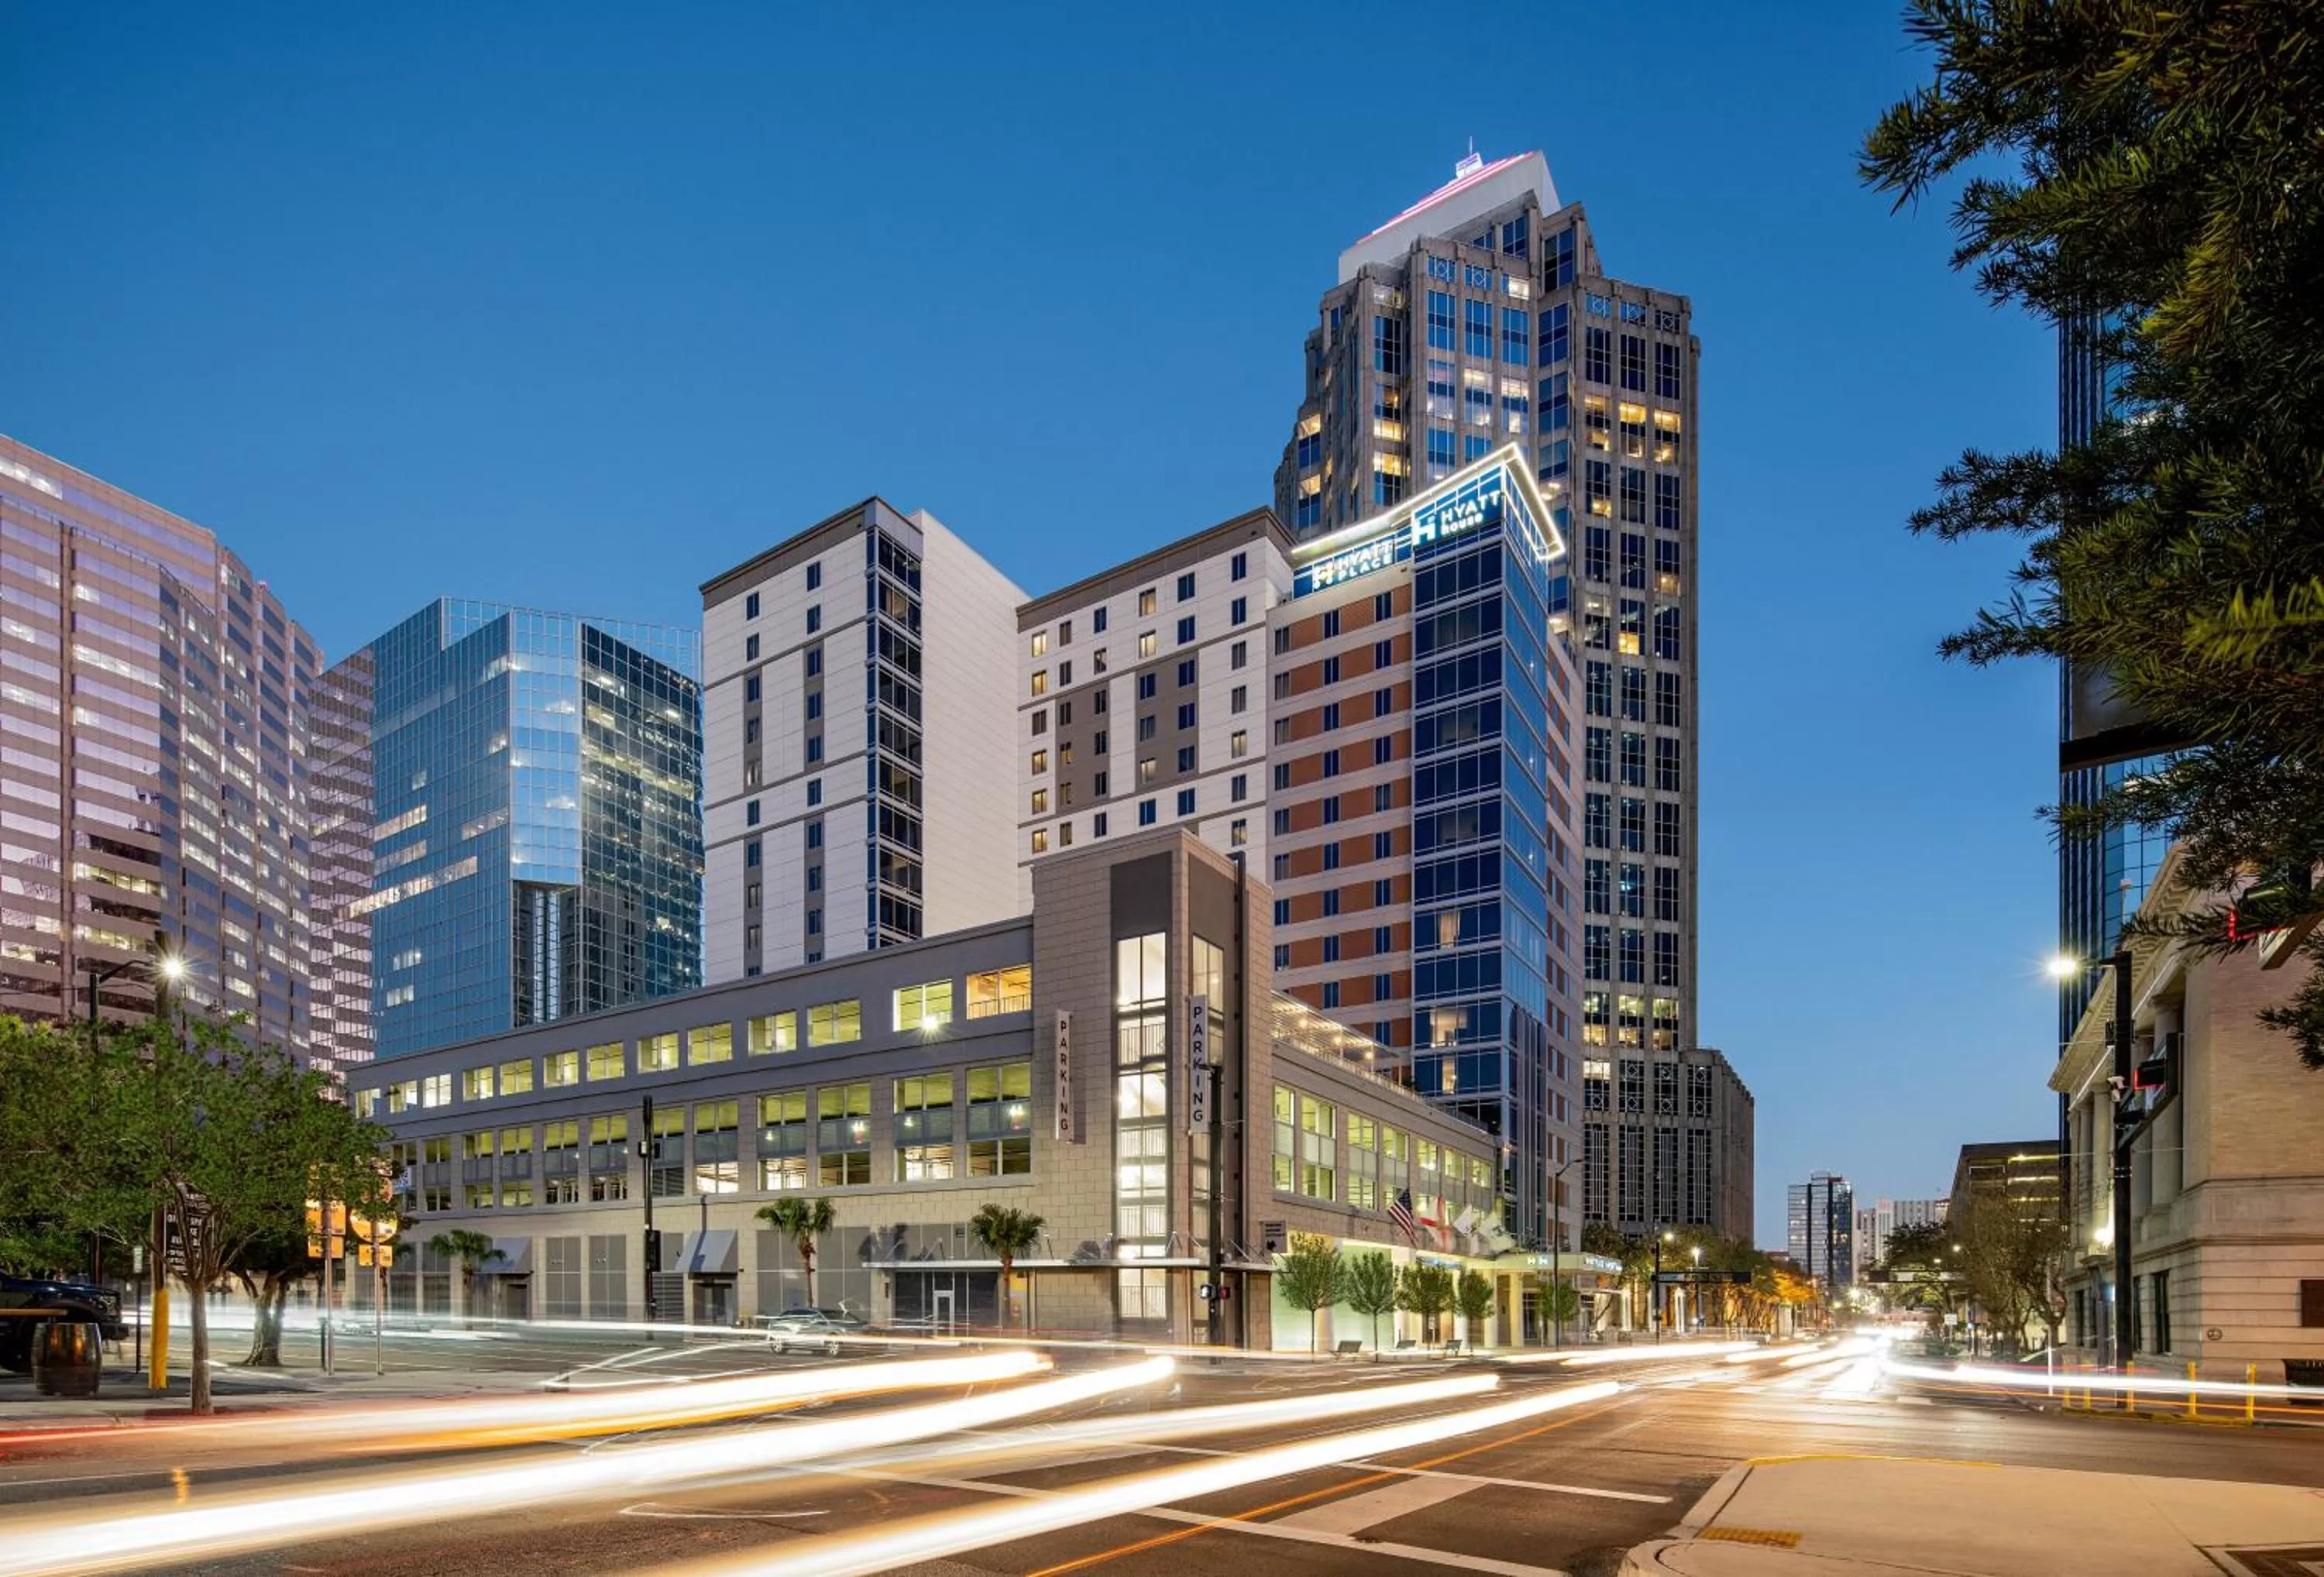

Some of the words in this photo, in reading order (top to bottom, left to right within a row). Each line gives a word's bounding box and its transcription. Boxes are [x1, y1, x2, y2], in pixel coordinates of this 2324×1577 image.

[1441, 490, 1501, 523] HYATT
[1338, 552, 1393, 581] PLACE
[1339, 540, 1392, 569] HYATT
[1060, 1022, 1068, 1130] PARKING
[1193, 1006, 1203, 1122] PARKING
